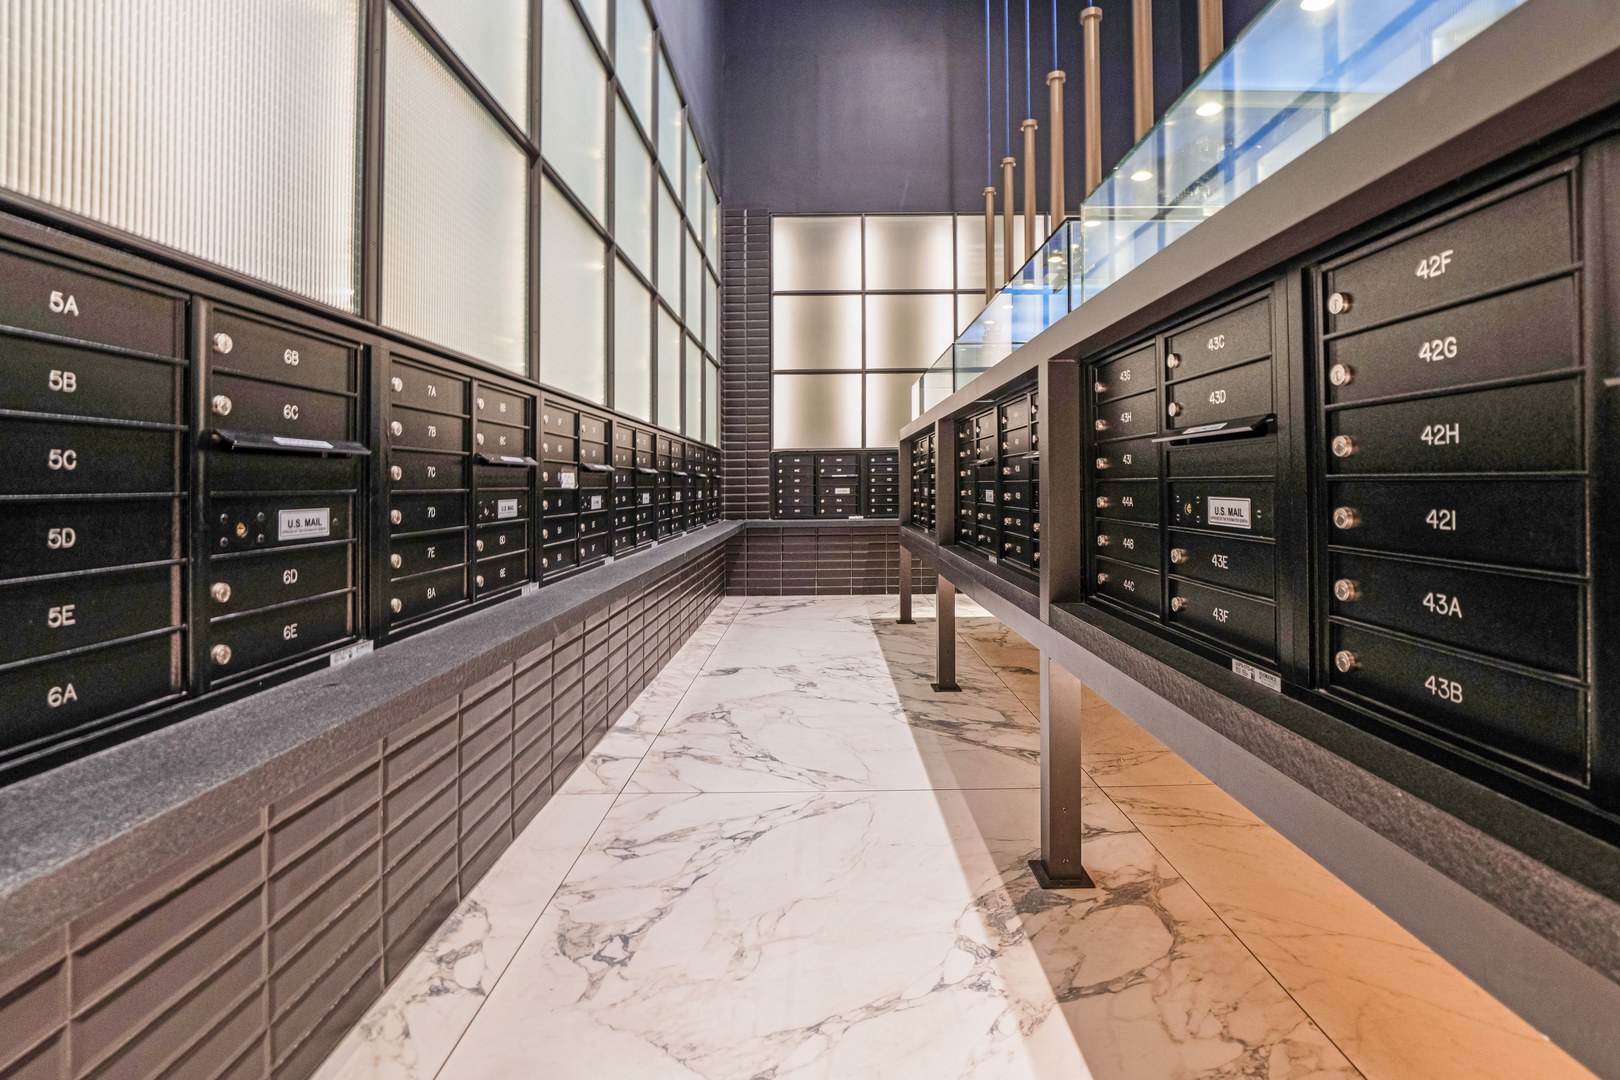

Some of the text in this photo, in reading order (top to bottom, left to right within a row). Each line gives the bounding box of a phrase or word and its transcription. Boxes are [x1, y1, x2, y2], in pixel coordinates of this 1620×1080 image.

[1416, 250, 1453, 279] 42F
[50, 291, 79, 316] 5A
[1207, 334, 1225, 351] 43C
[1419, 337, 1457, 362] 42G
[283, 348, 300, 366] 6B
[49, 370, 76, 392] 5B
[1119, 369, 1131, 382] 43G
[427, 384, 437, 398] 7A
[1208, 389, 1227, 405] 43D
[283, 403, 299, 421] 6C
[1120, 411, 1132, 423] 43H
[427, 425, 437, 438] 7B
[1421, 423, 1459, 445] 42H
[49, 449, 76, 470] 5C
[1122, 453, 1132, 465] 43I
[427, 465, 436, 478] 7C
[427, 506, 436, 518] 7D
[1214, 506, 1244, 518] U.S. MAIL
[1426, 509, 1455, 530] 42I
[287, 518, 322, 529] U.S. MAIL
[48, 528, 75, 548] 5D
[1122, 537, 1135, 550] 44B
[427, 546, 436, 559] 7E
[1211, 553, 1229, 570] 43E
[282, 568, 298, 585] 6D
[426, 586, 436, 600] 8A
[1123, 579, 1135, 592] 44C
[1423, 593, 1462, 618] 43A
[48, 605, 75, 627] 5E
[1212, 607, 1230, 623] 43F
[283, 622, 298, 641] 6E
[48, 683, 77, 707] 6A
[1425, 675, 1462, 703] 43B
